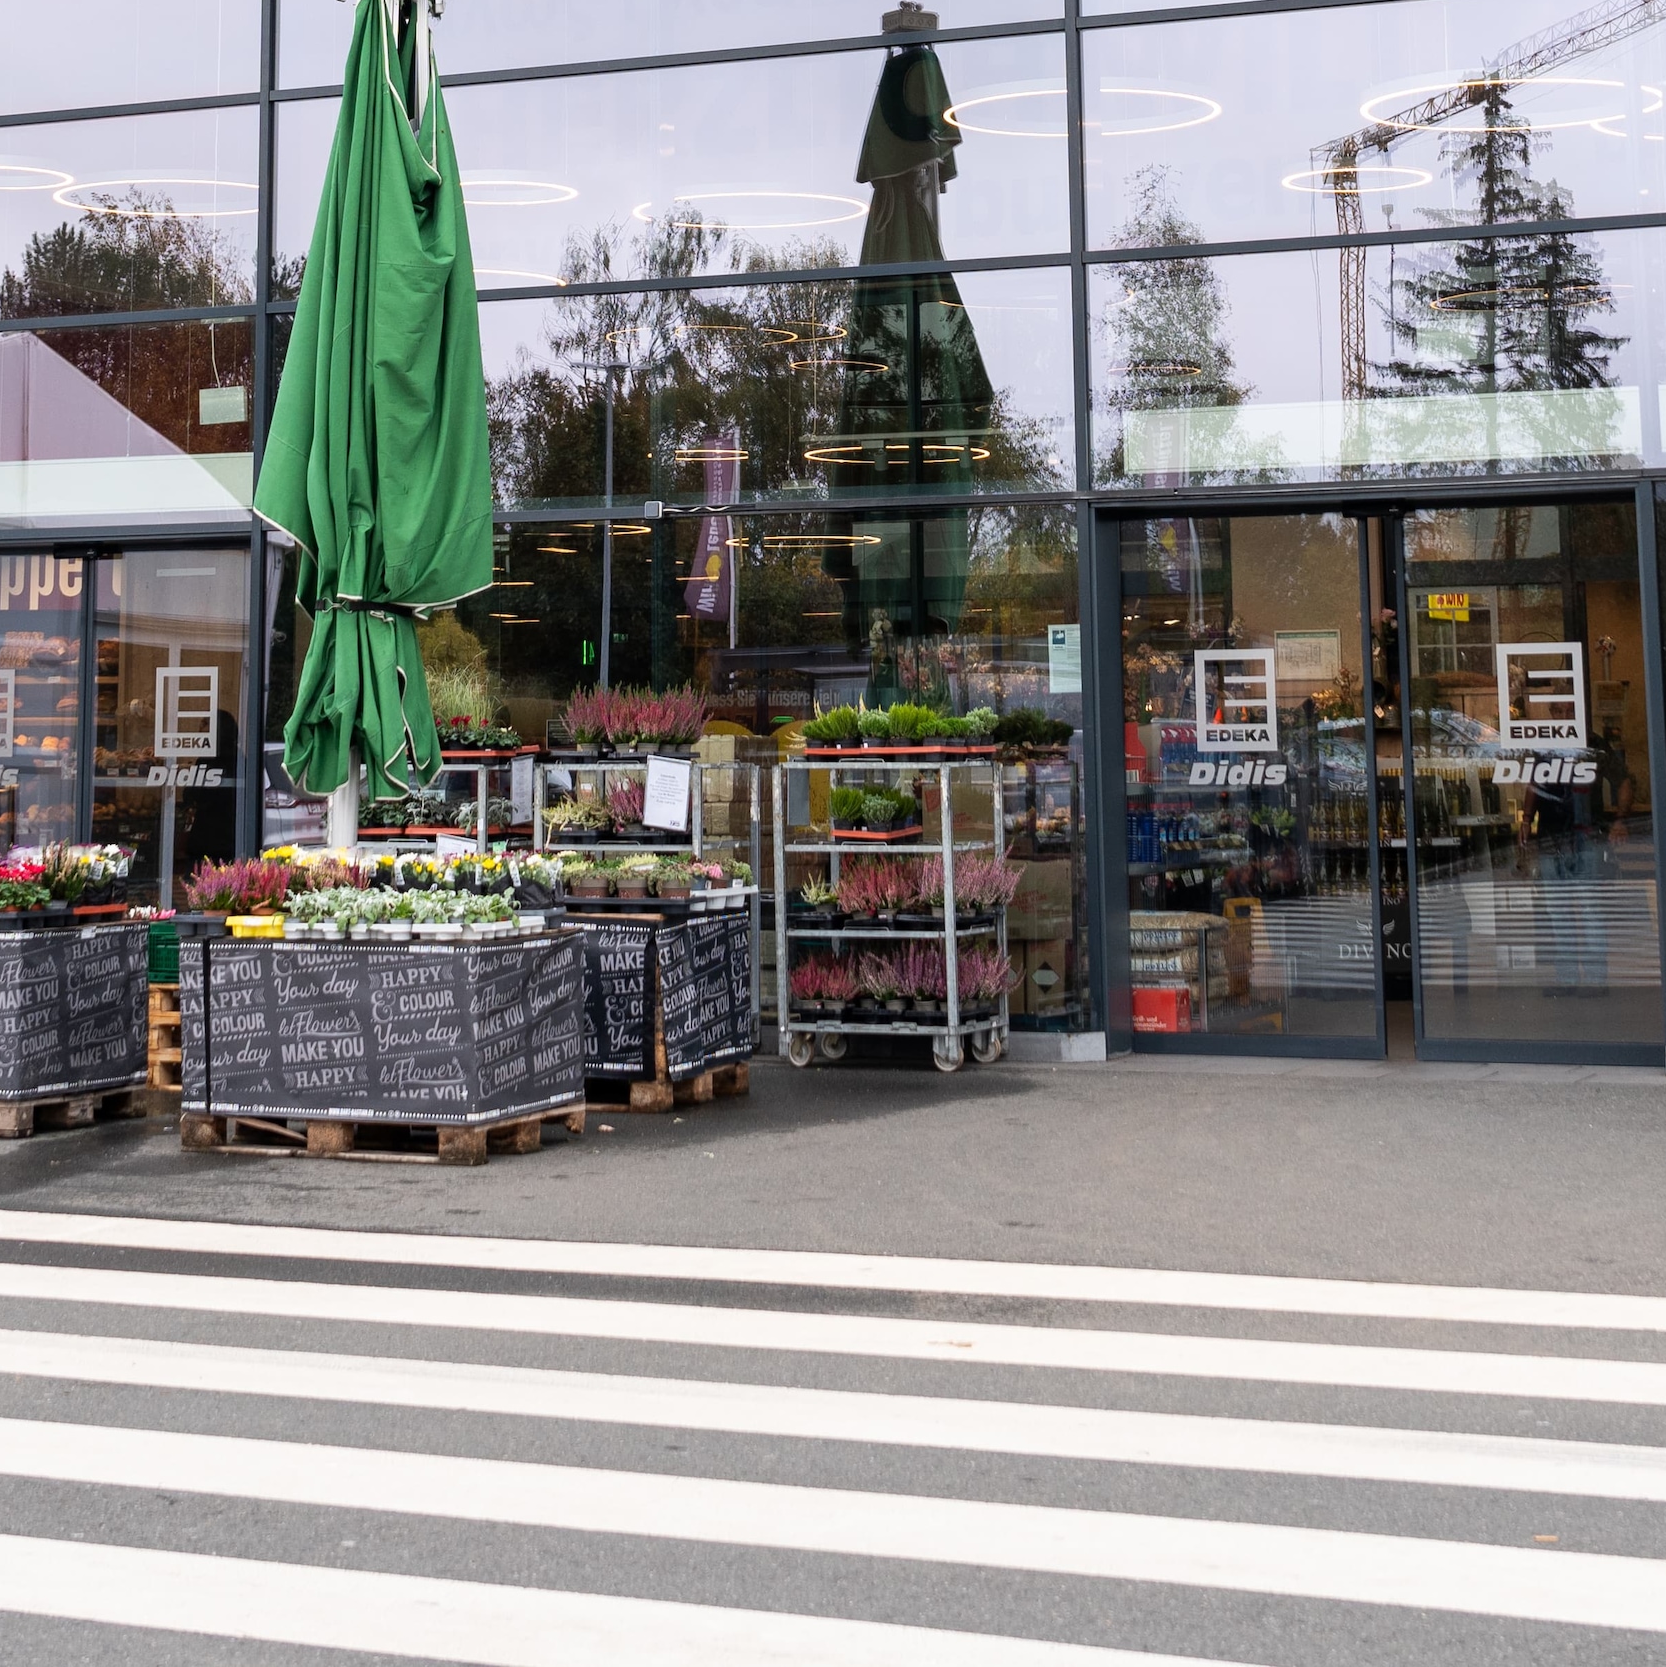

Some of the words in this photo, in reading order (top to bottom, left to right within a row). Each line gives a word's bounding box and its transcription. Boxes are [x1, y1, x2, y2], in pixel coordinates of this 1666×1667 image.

[161, 737, 211, 749] EDEKA
[1206, 727, 1270, 742] EDEKA
[1510, 725, 1579, 740] EDEKA
[146, 765, 223, 787] Didis
[1189, 760, 1287, 786] Didis
[1492, 757, 1598, 784] Didis
[72, 934, 113, 960] HAPPY
[671, 939, 686, 960] YOU
[1338, 943, 1412, 959] DIVNO
[85, 955, 121, 980] COLOUR
[230, 959, 263, 981] YOU
[464, 955, 500, 982] Your
[542, 947, 574, 975] COLOUR
[600, 951, 644, 972] MAKE
[35, 979, 60, 1001] YOU
[274, 977, 321, 1005] Your
[323, 970, 359, 999] day
[381, 965, 442, 989] HAPPY
[68, 991, 100, 1018] Your
[102, 982, 125, 1005] day
[399, 989, 455, 1013] COLOUR
[528, 986, 557, 1017] Your
[663, 983, 697, 1013] COLOUR
[716, 994, 731, 1014] YOU
[4, 1006, 52, 1034] HAPPY
[211, 1012, 266, 1036] COLOUR
[473, 1018, 503, 1041] MAKE
[504, 1003, 525, 1030] YOU
[22, 1030, 59, 1056] COLOUR
[374, 1024, 422, 1053] Your
[425, 1017, 462, 1046] day
[71, 1045, 102, 1069] MAKE
[105, 1038, 127, 1060] YOU
[237, 1039, 272, 1068] day
[282, 1040, 328, 1065] MAKE
[330, 1036, 365, 1058] YOU
[484, 1034, 521, 1063] HAPPY
[533, 1044, 561, 1073] MAKE
[561, 1035, 581, 1060] YOU
[296, 1066, 356, 1089] HAPPY
[494, 1056, 527, 1086] COLOUR
